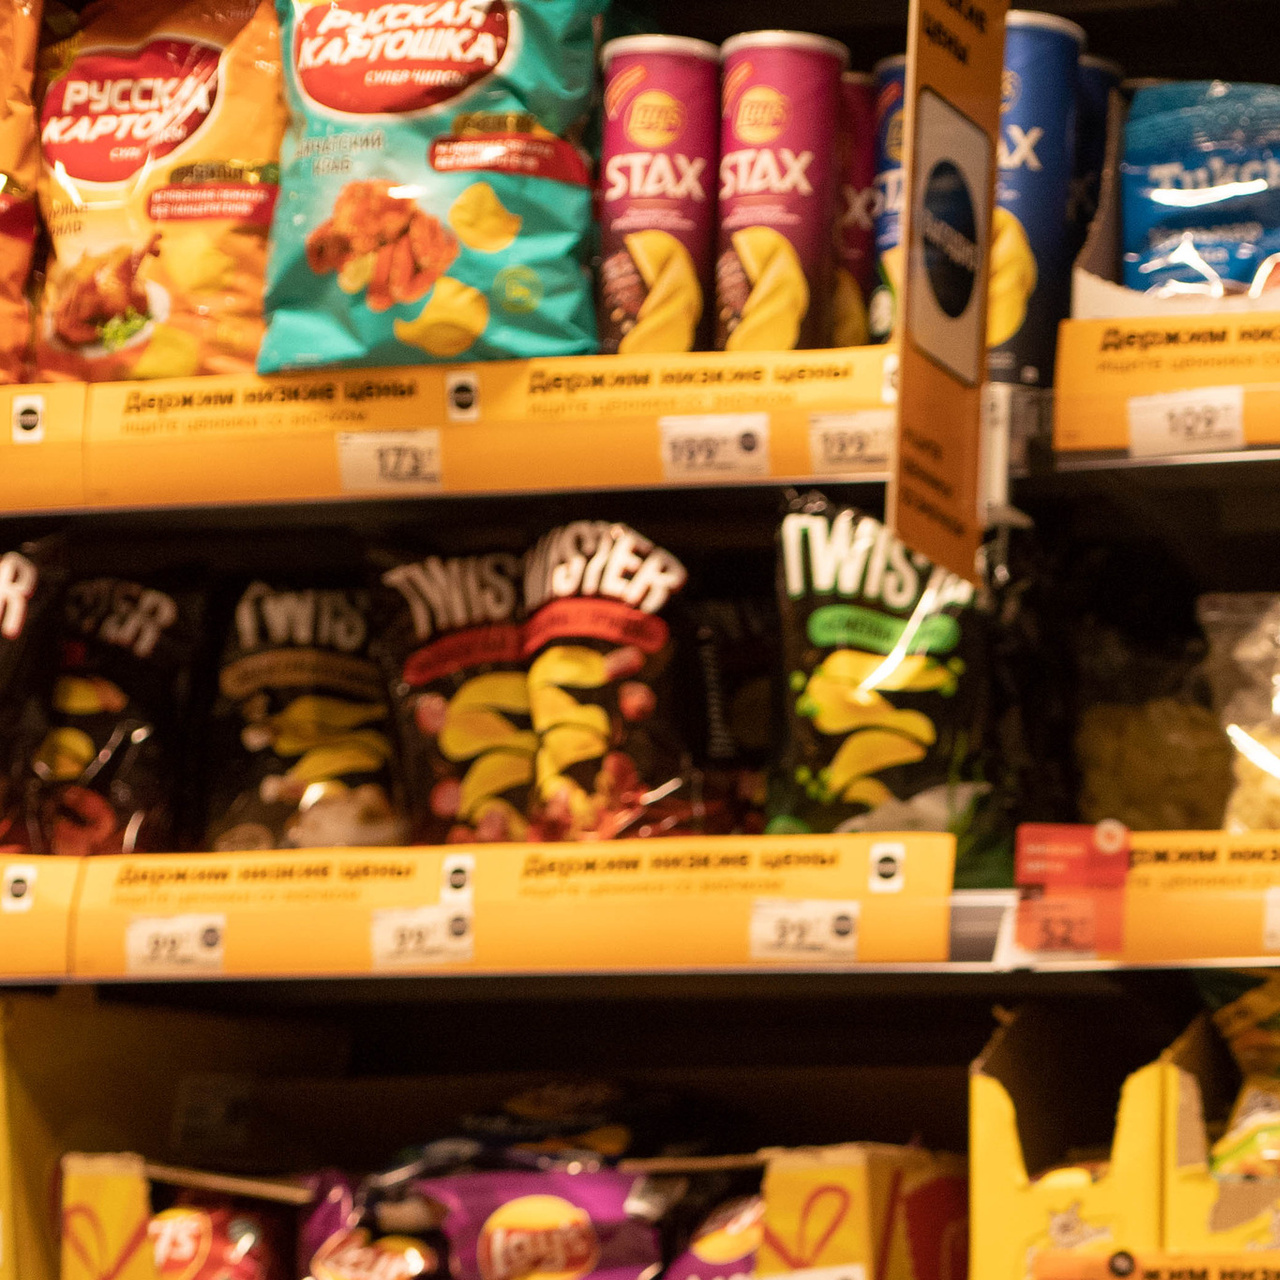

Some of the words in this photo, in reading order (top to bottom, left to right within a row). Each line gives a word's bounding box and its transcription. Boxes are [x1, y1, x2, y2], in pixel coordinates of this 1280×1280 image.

[298, 27, 498, 69] КАРТОШКА
[605, 151, 707, 201] STAX
[720, 149, 815, 198] STAX
[1099, 327, 1228, 352] Держим
